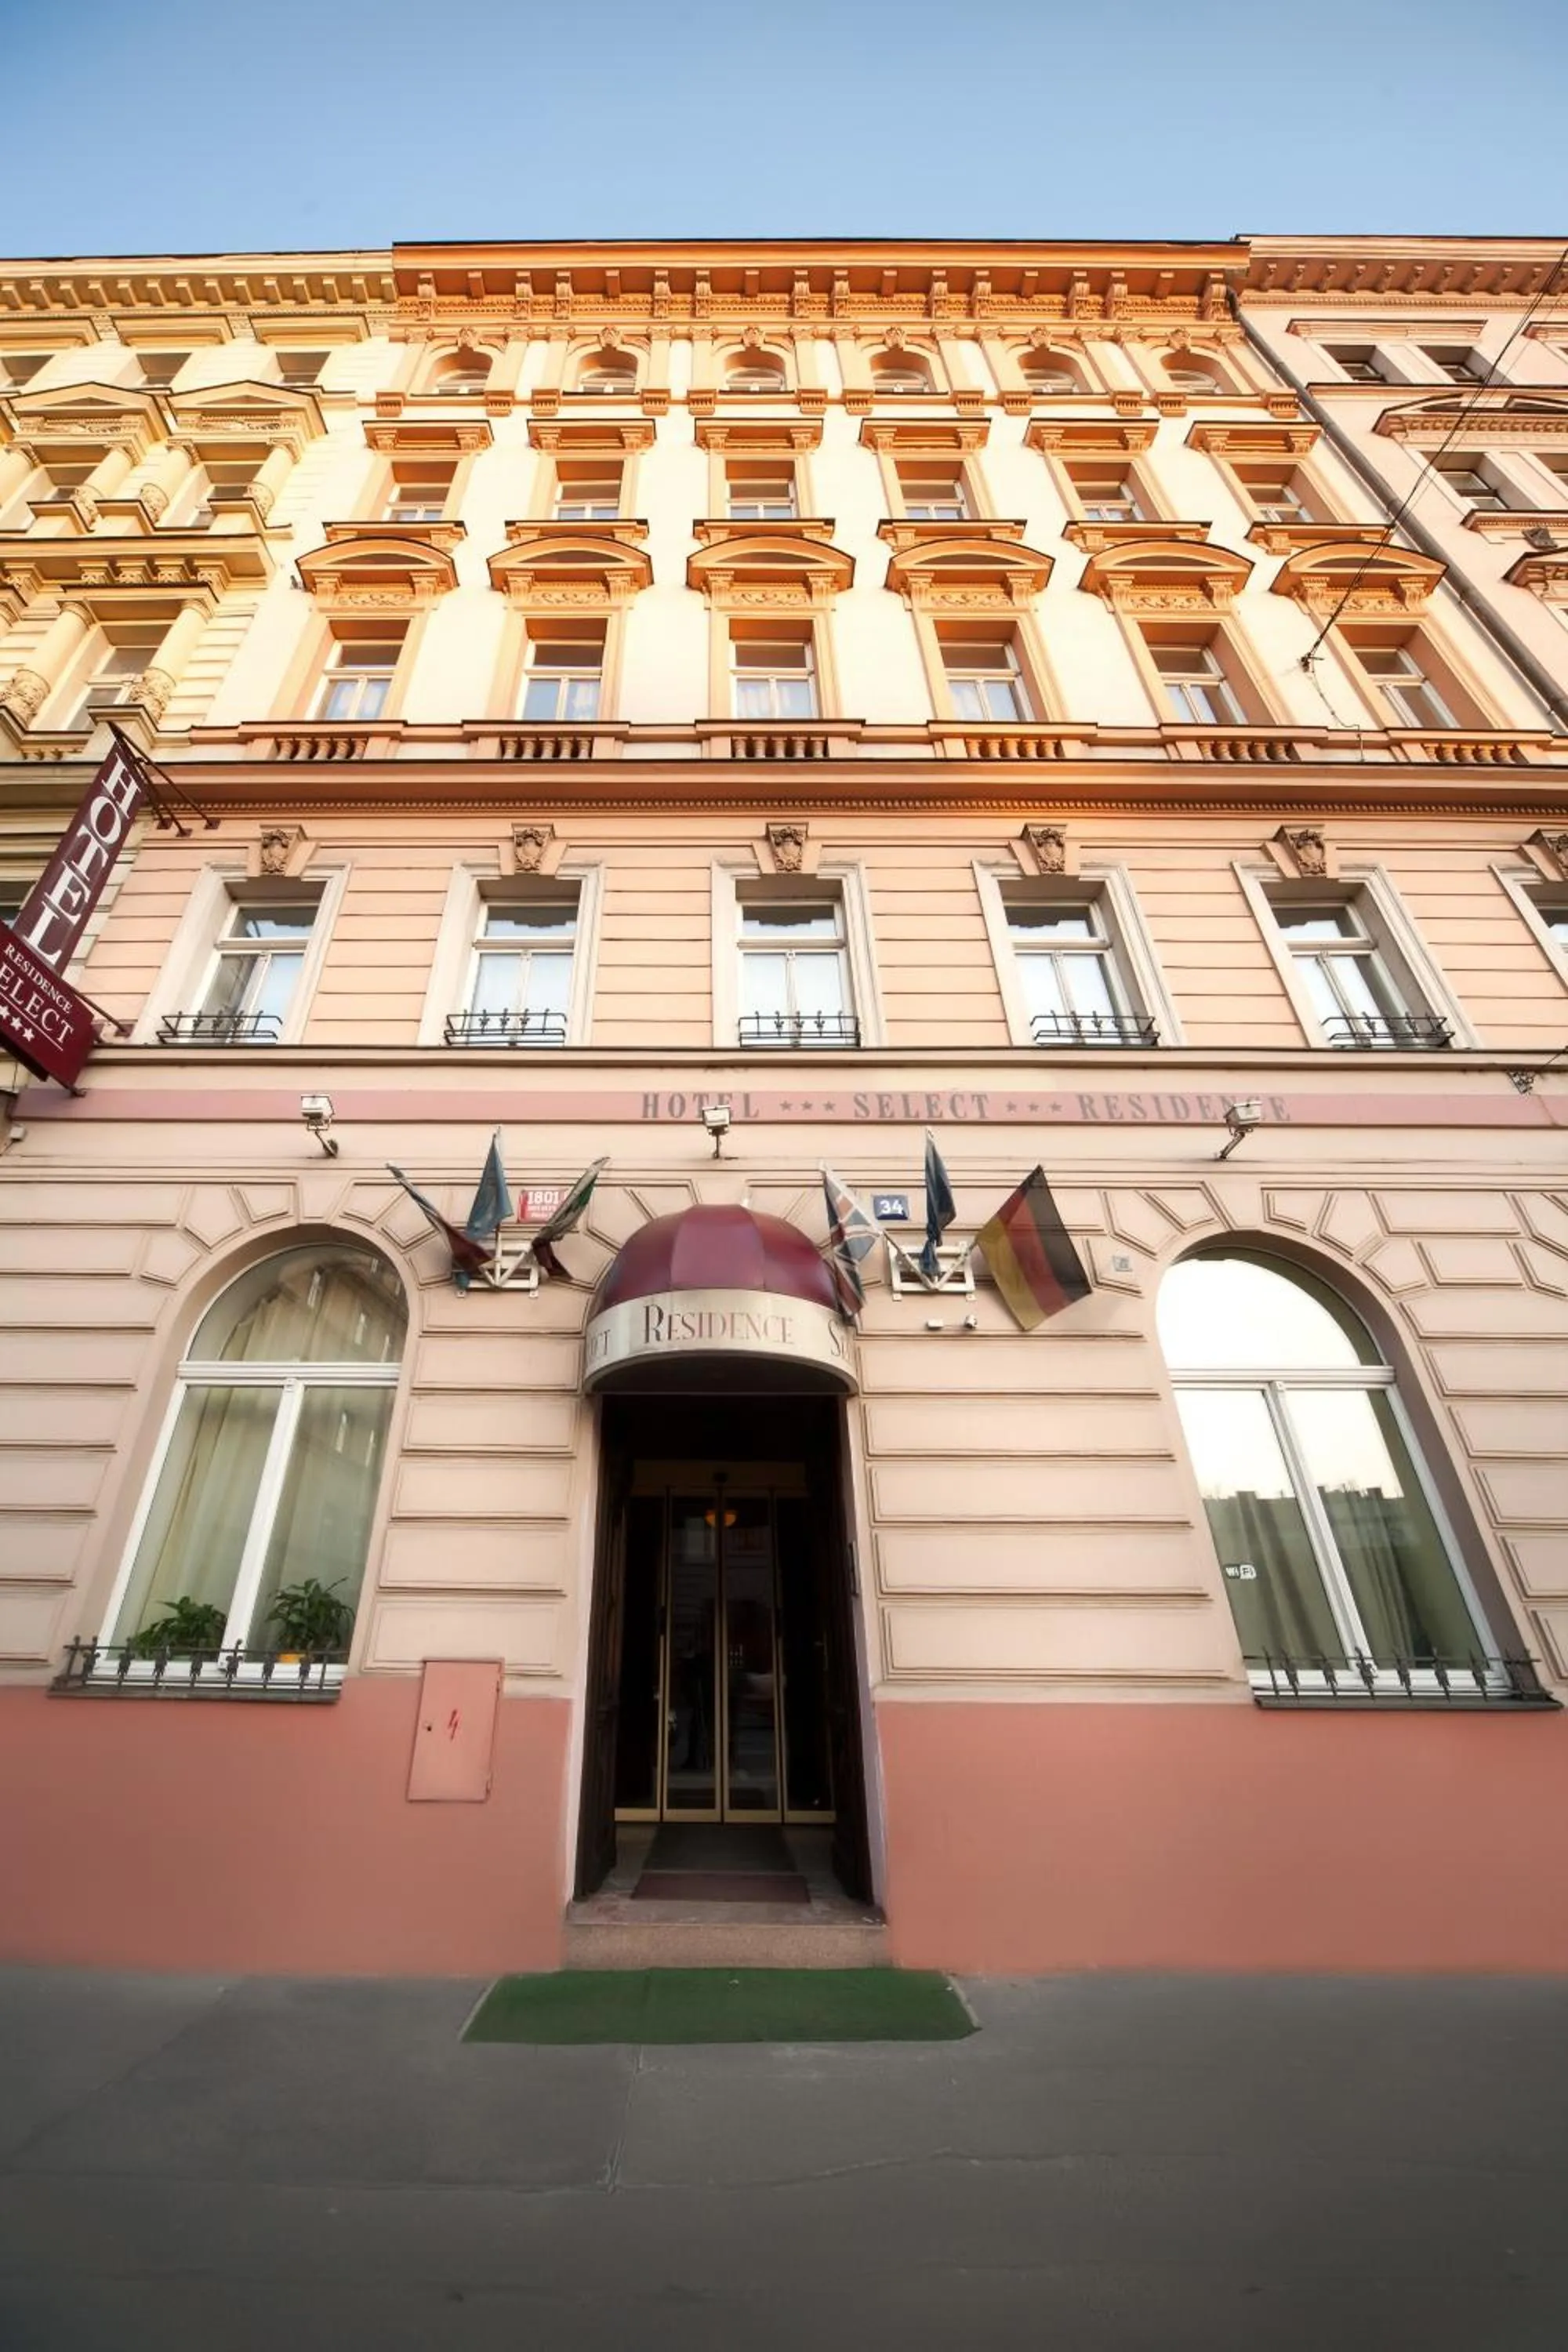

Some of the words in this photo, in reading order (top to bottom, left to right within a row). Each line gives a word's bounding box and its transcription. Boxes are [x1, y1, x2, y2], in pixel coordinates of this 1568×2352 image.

[22, 753, 141, 966] HOTEL
[4, 943, 72, 1014] RESIDENCE
[0, 962, 74, 1044] ELECT
[853, 1093, 989, 1120] SELECT
[1077, 1094, 1290, 1122] RESIDENE
[527, 1191, 559, 1205] 1801
[879, 1200, 904, 1214] 34
[643, 1303, 795, 1345] RESIDENCE
